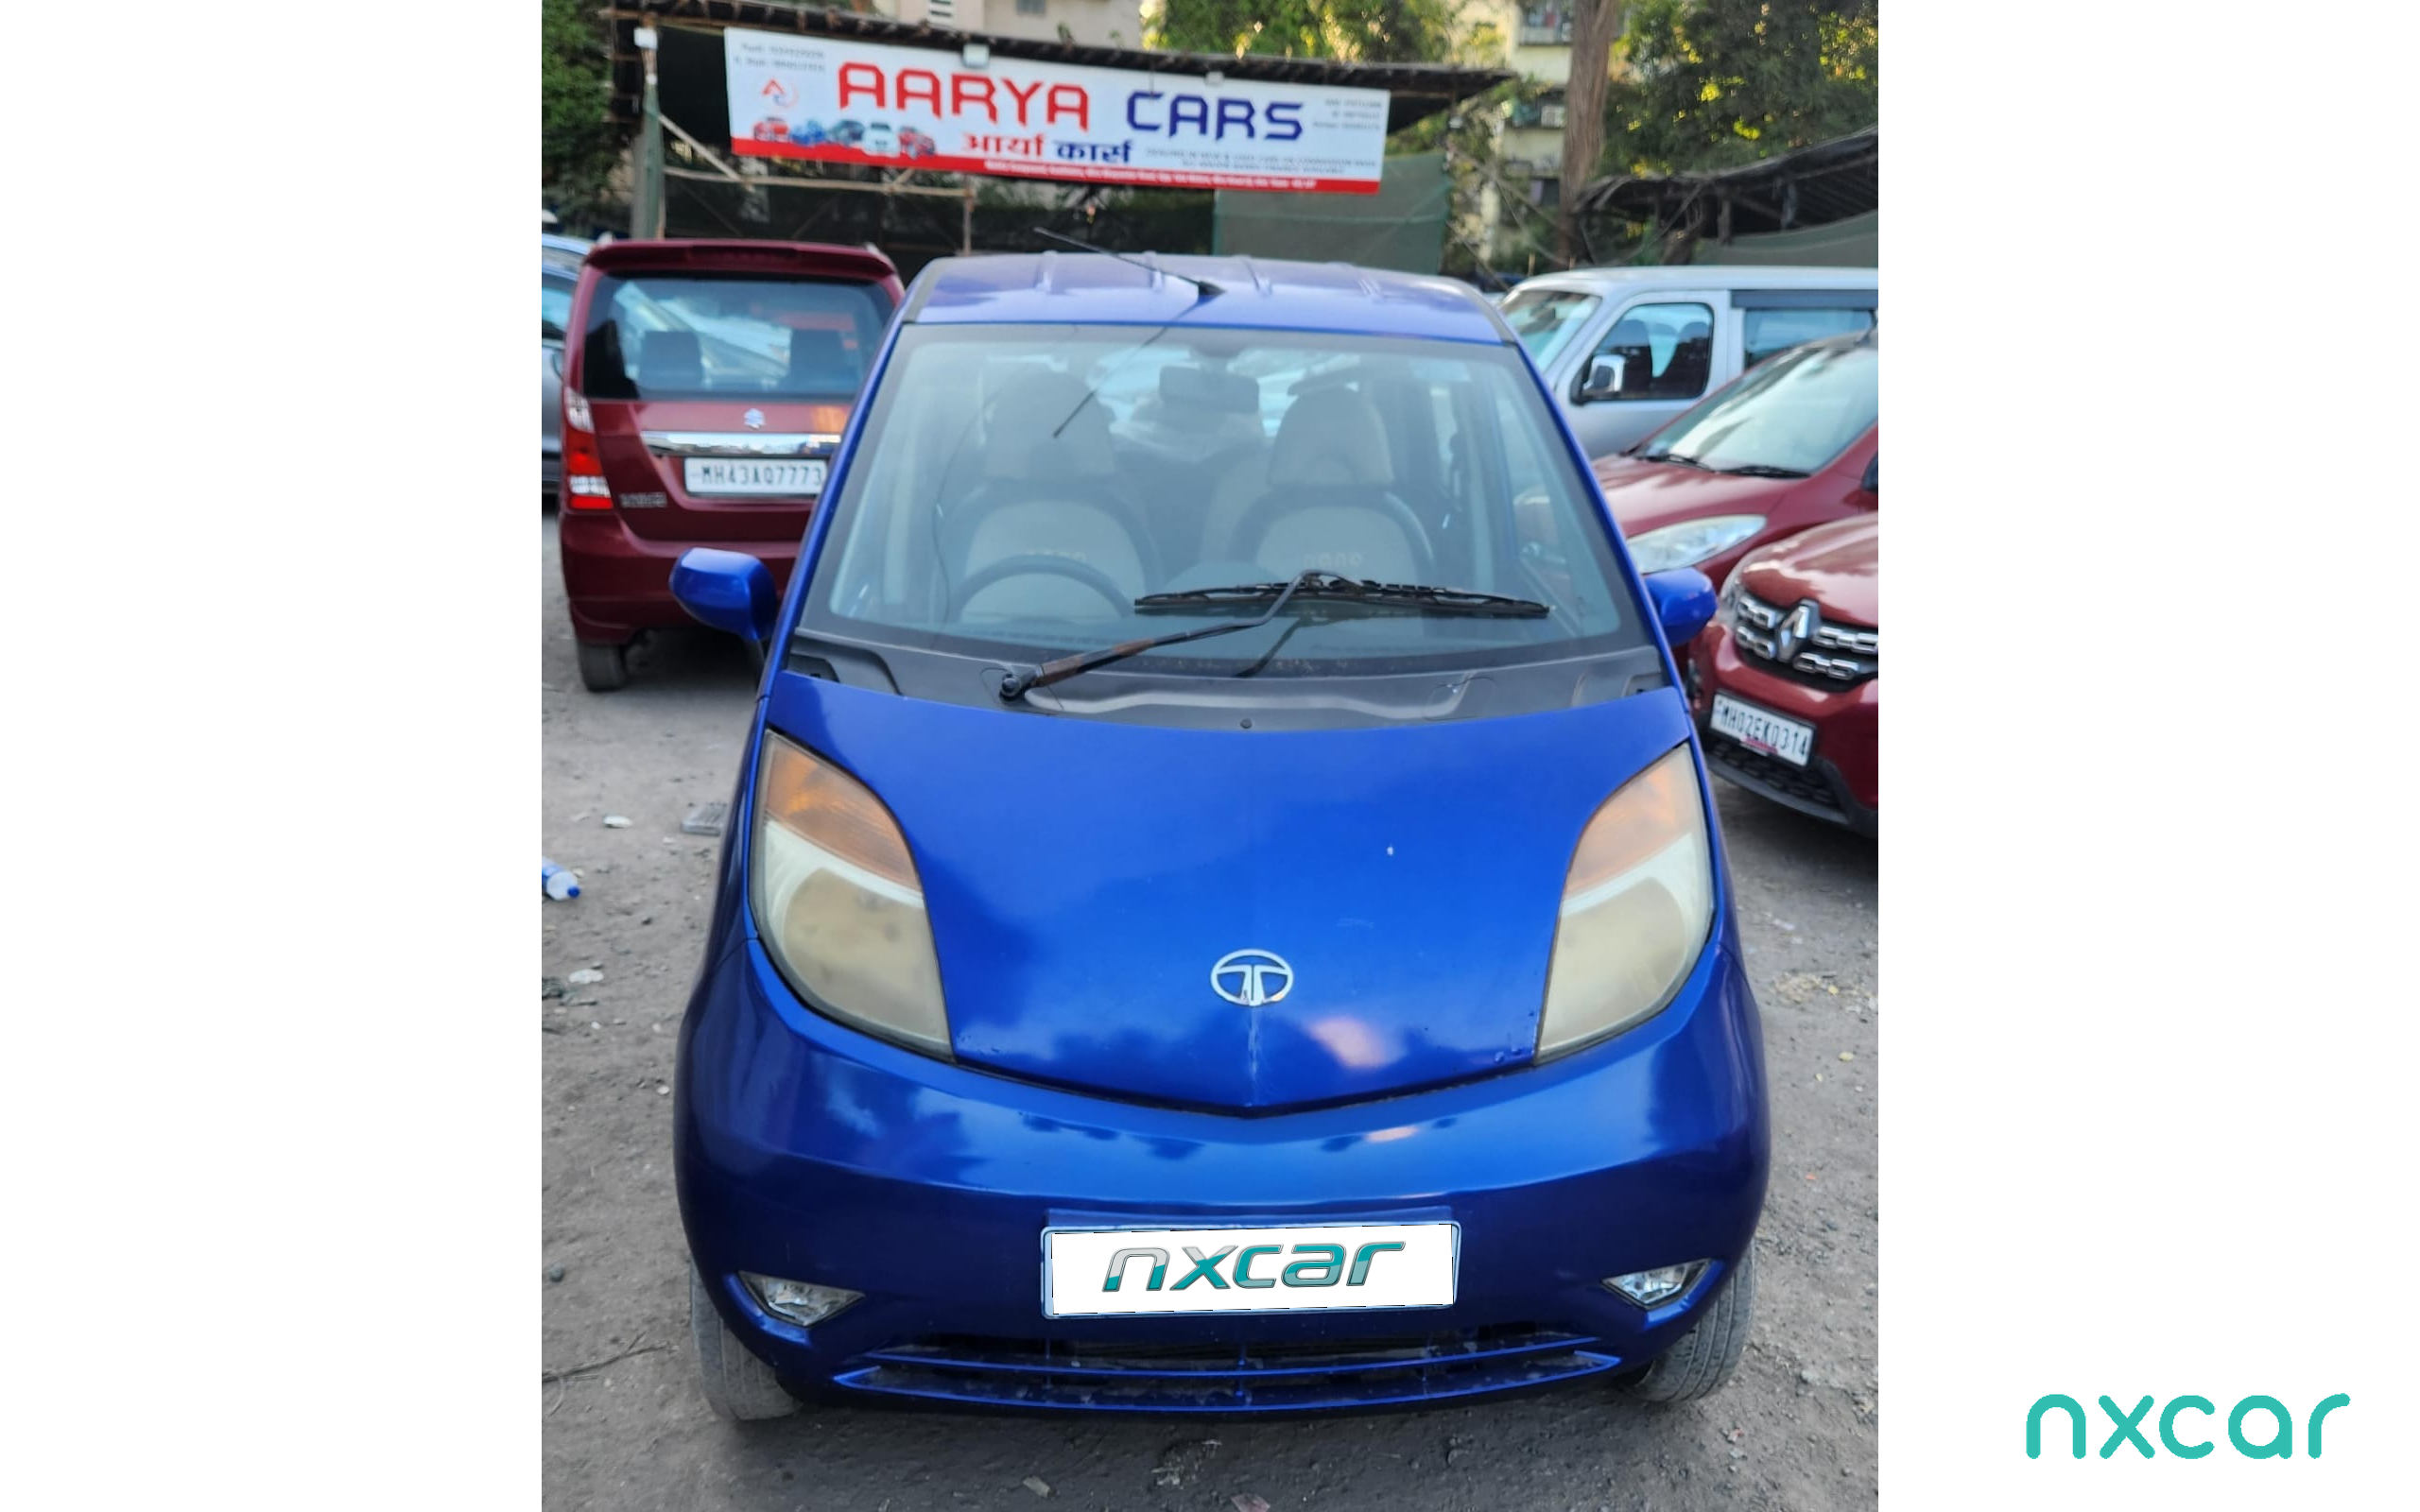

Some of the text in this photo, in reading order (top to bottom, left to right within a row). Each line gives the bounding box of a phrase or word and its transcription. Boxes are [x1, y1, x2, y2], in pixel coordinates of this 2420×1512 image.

[838, 61, 1304, 141] AARYA CARS
[964, 132, 1044, 157] आर्या
[1053, 139, 1132, 163] कार्स
[1720, 705, 1809, 757] MH02EK0314
